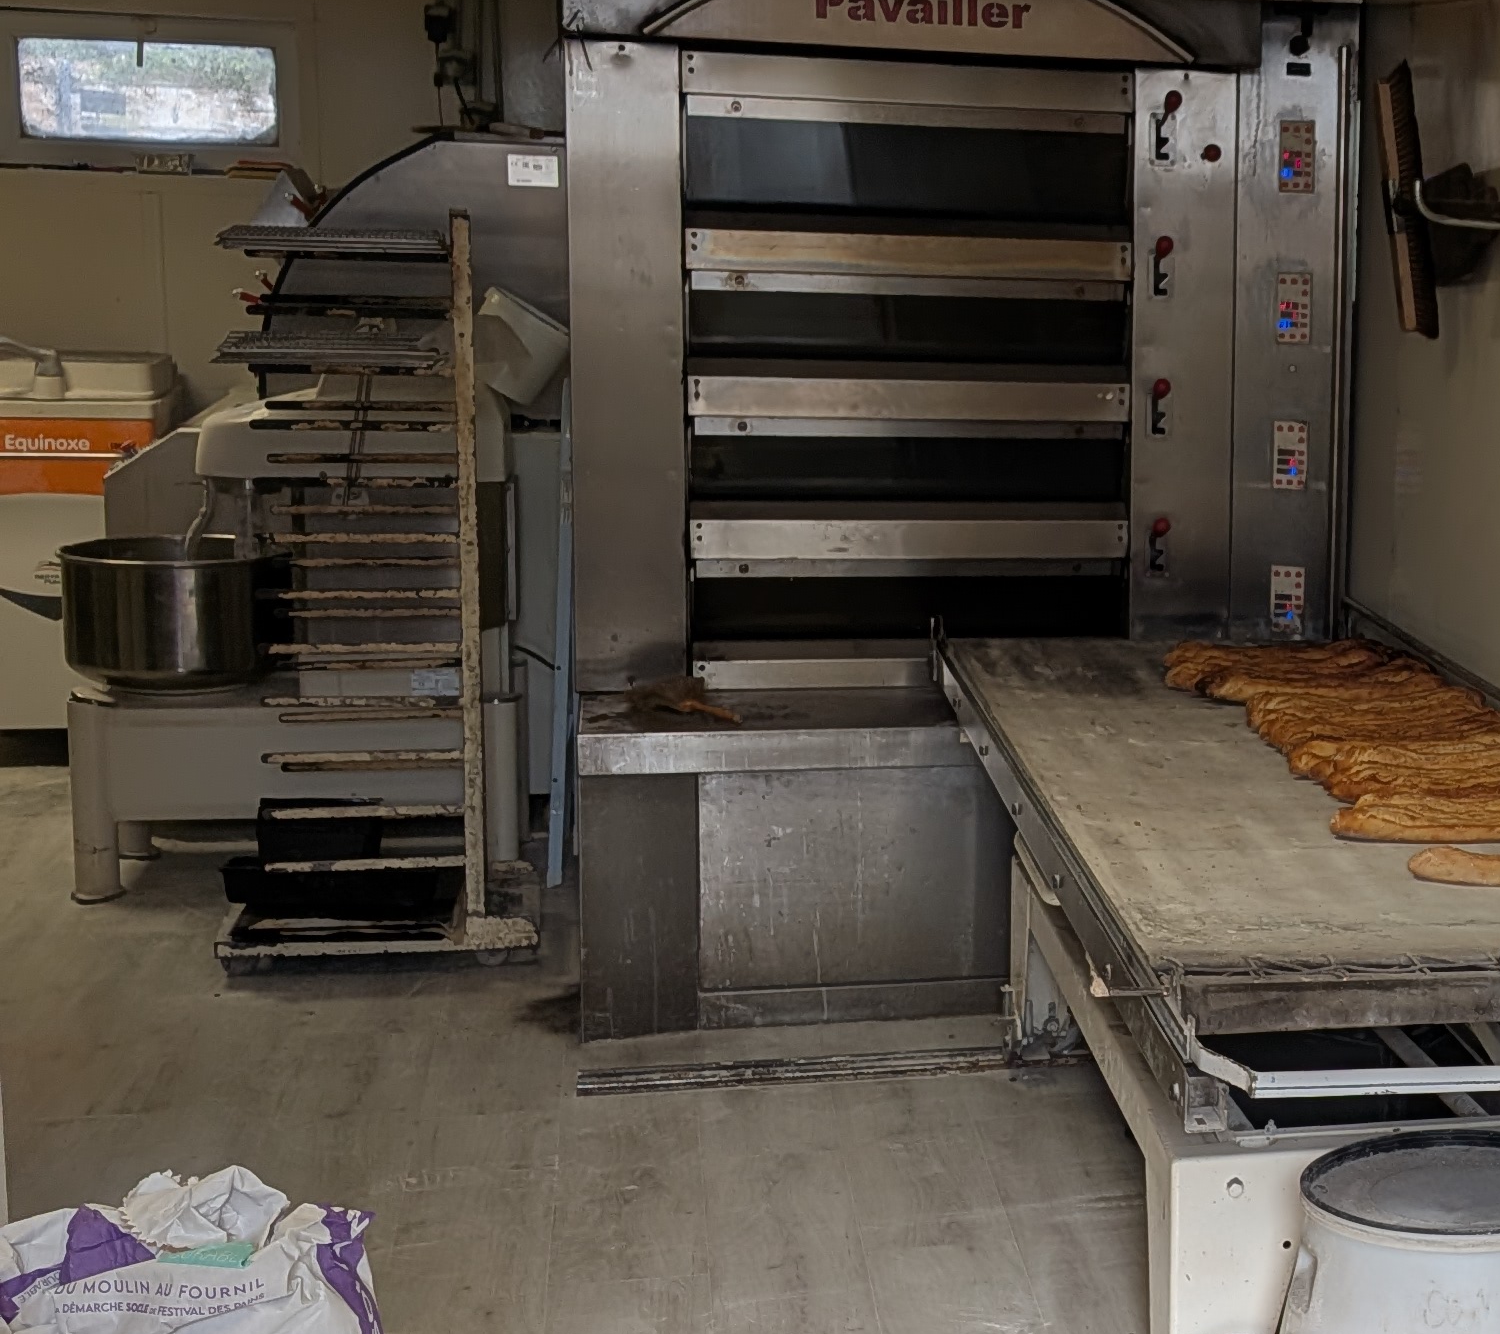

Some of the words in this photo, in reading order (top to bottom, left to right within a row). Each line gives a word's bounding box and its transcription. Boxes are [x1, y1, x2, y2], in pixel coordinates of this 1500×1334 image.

[5, 434, 90, 451] Equinoxe
[83, 1280, 150, 1294] MOULIN
[156, 1283, 172, 1297] AU
[179, 1278, 265, 1299] FOURNIL
[62, 1301, 124, 1314] DÉMARCHE
[157, 1306, 202, 1317] FESTIVAL
[208, 1305, 231, 1315] DES
